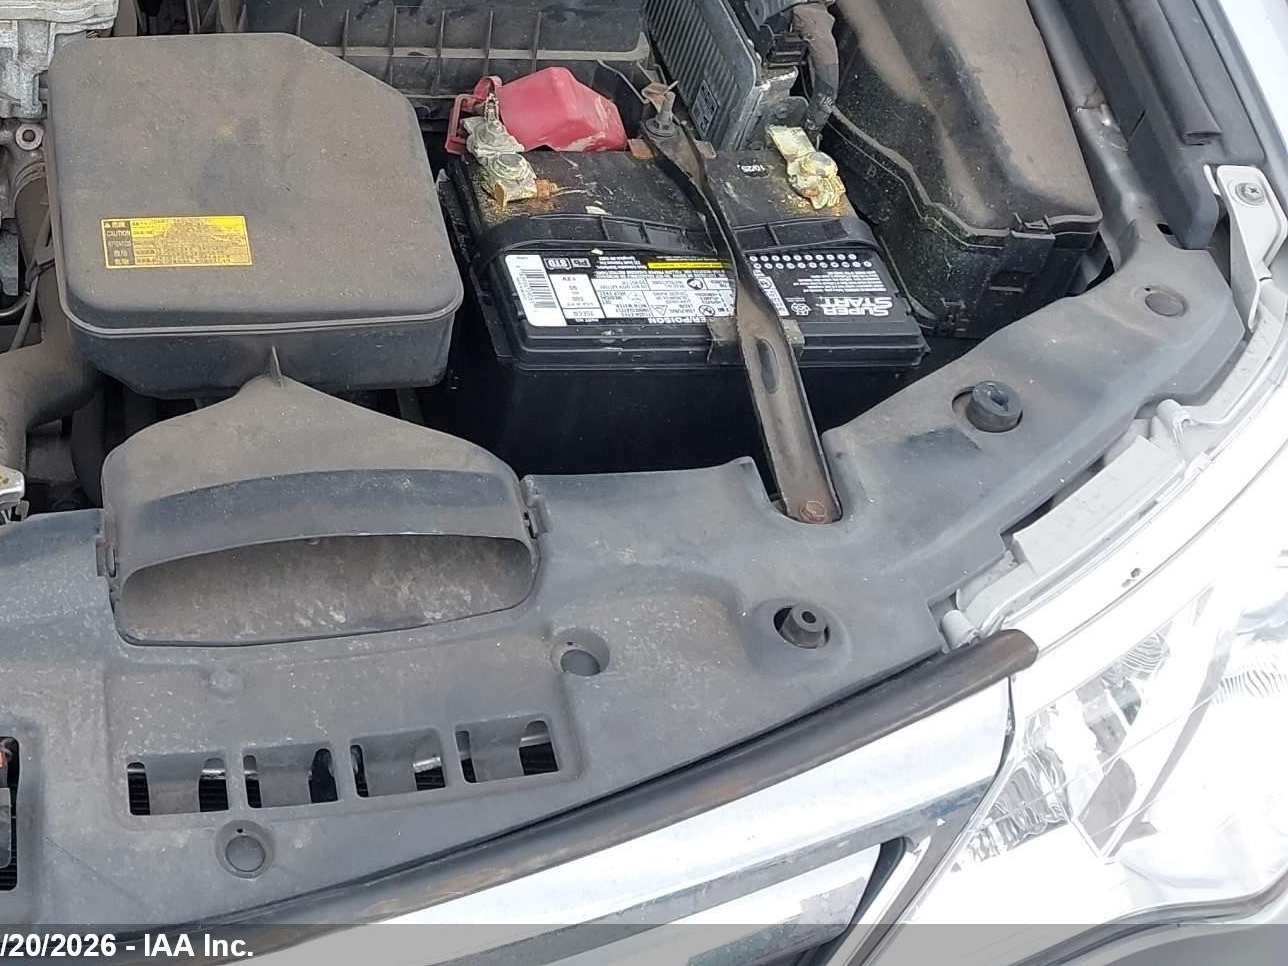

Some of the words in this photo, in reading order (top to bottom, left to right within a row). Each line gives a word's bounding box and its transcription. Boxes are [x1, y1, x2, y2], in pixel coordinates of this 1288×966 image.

[819, 296, 893, 309] START
[823, 307, 889, 317] SUPER
[647, 316, 707, 325] ER/POISON
